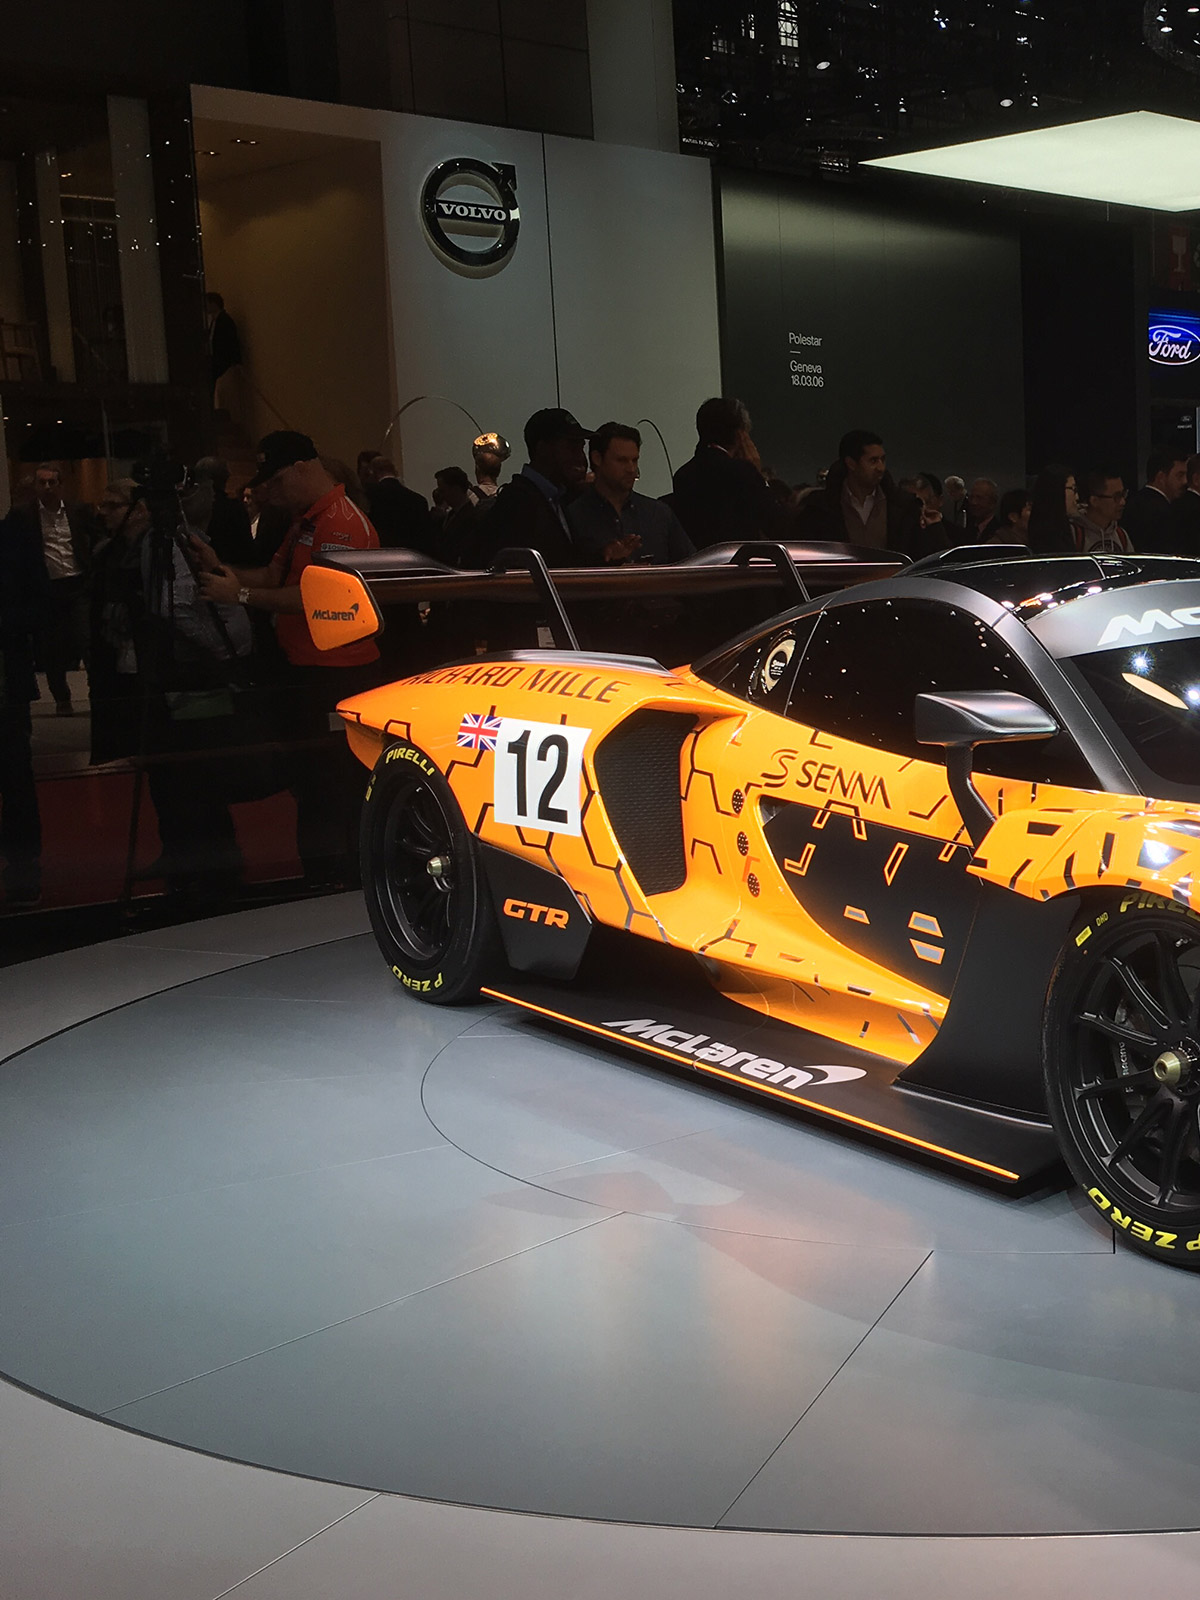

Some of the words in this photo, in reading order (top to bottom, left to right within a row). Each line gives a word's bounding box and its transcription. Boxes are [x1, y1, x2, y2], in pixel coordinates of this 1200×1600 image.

[437, 202, 507, 221] VOLVO
[788, 332, 823, 346] Polestar
[1149, 329, 1192, 359] Ford
[790, 360, 822, 374] Geneva
[791, 374, 825, 388] 18.03.06
[312, 609, 355, 621] McLaren
[400, 666, 526, 688] RICHARD
[519, 668, 632, 704] MILLE
[385, 747, 435, 776] PIRELLI
[507, 729, 569, 825] 12
[796, 760, 891, 810] SENNA
[503, 898, 569, 929] GTR
[392, 965, 431, 992] ZERO
[601, 1018, 814, 1090] McLaren
[1088, 1187, 1178, 1249] ZERO
